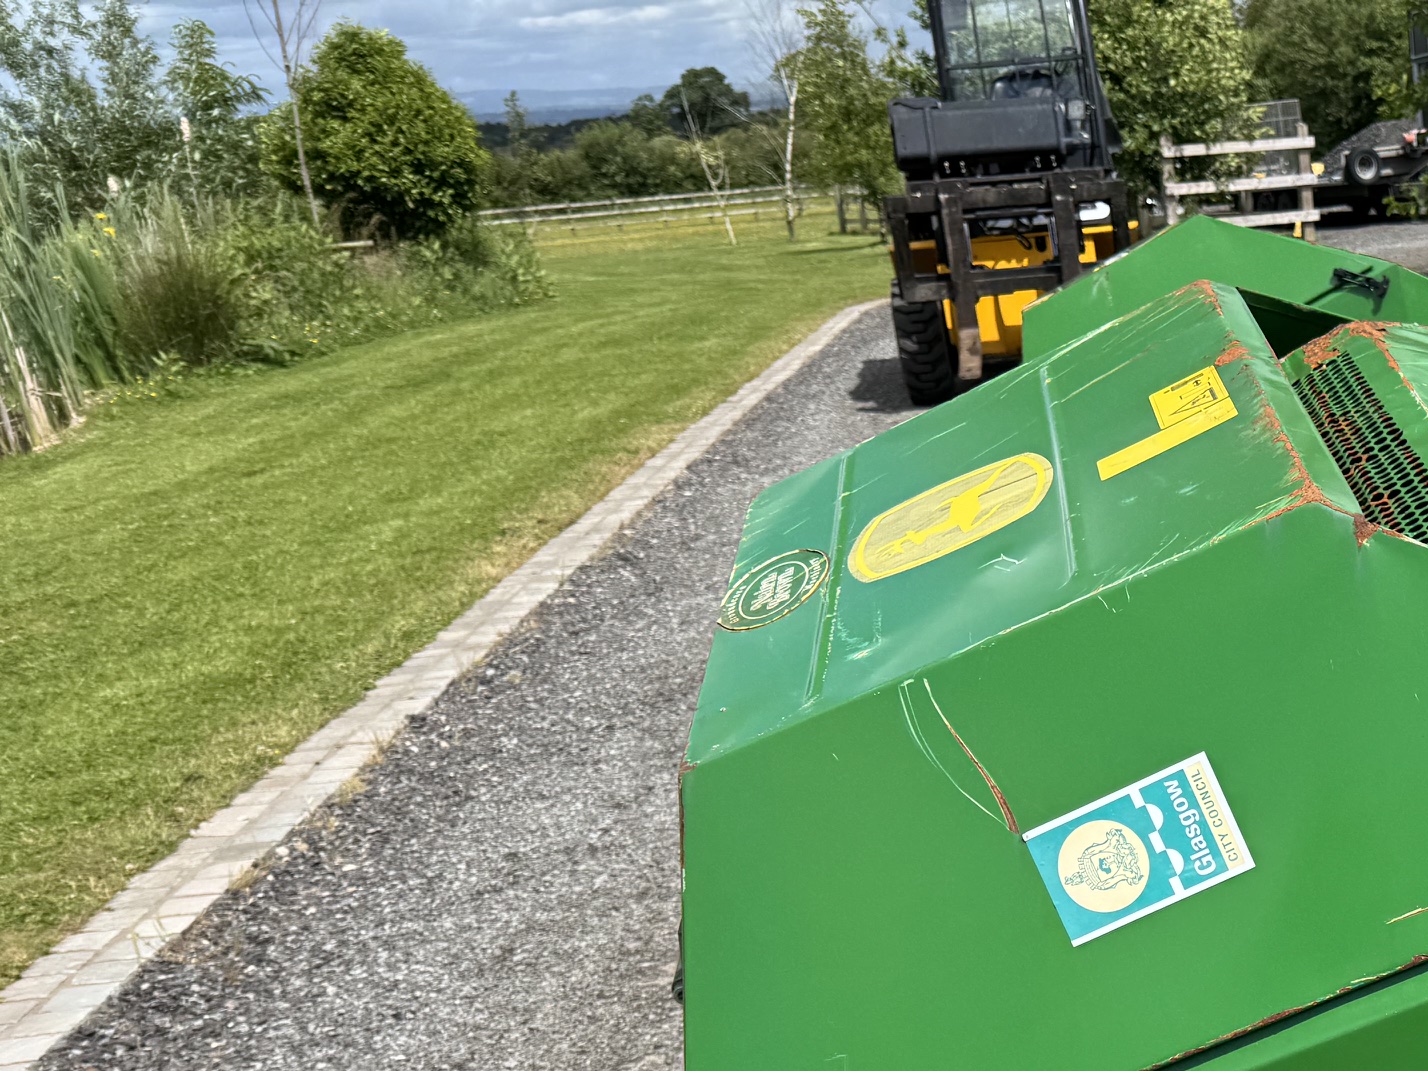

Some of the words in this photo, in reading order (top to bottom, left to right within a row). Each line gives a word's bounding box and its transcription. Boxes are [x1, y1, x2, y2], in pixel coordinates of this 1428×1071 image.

[767, 567, 794, 610] Brown
[1191, 768, 1223, 828] COUNCIL
[1164, 779, 1217, 876] Glasgow
[1218, 832, 1239, 862] CITY
